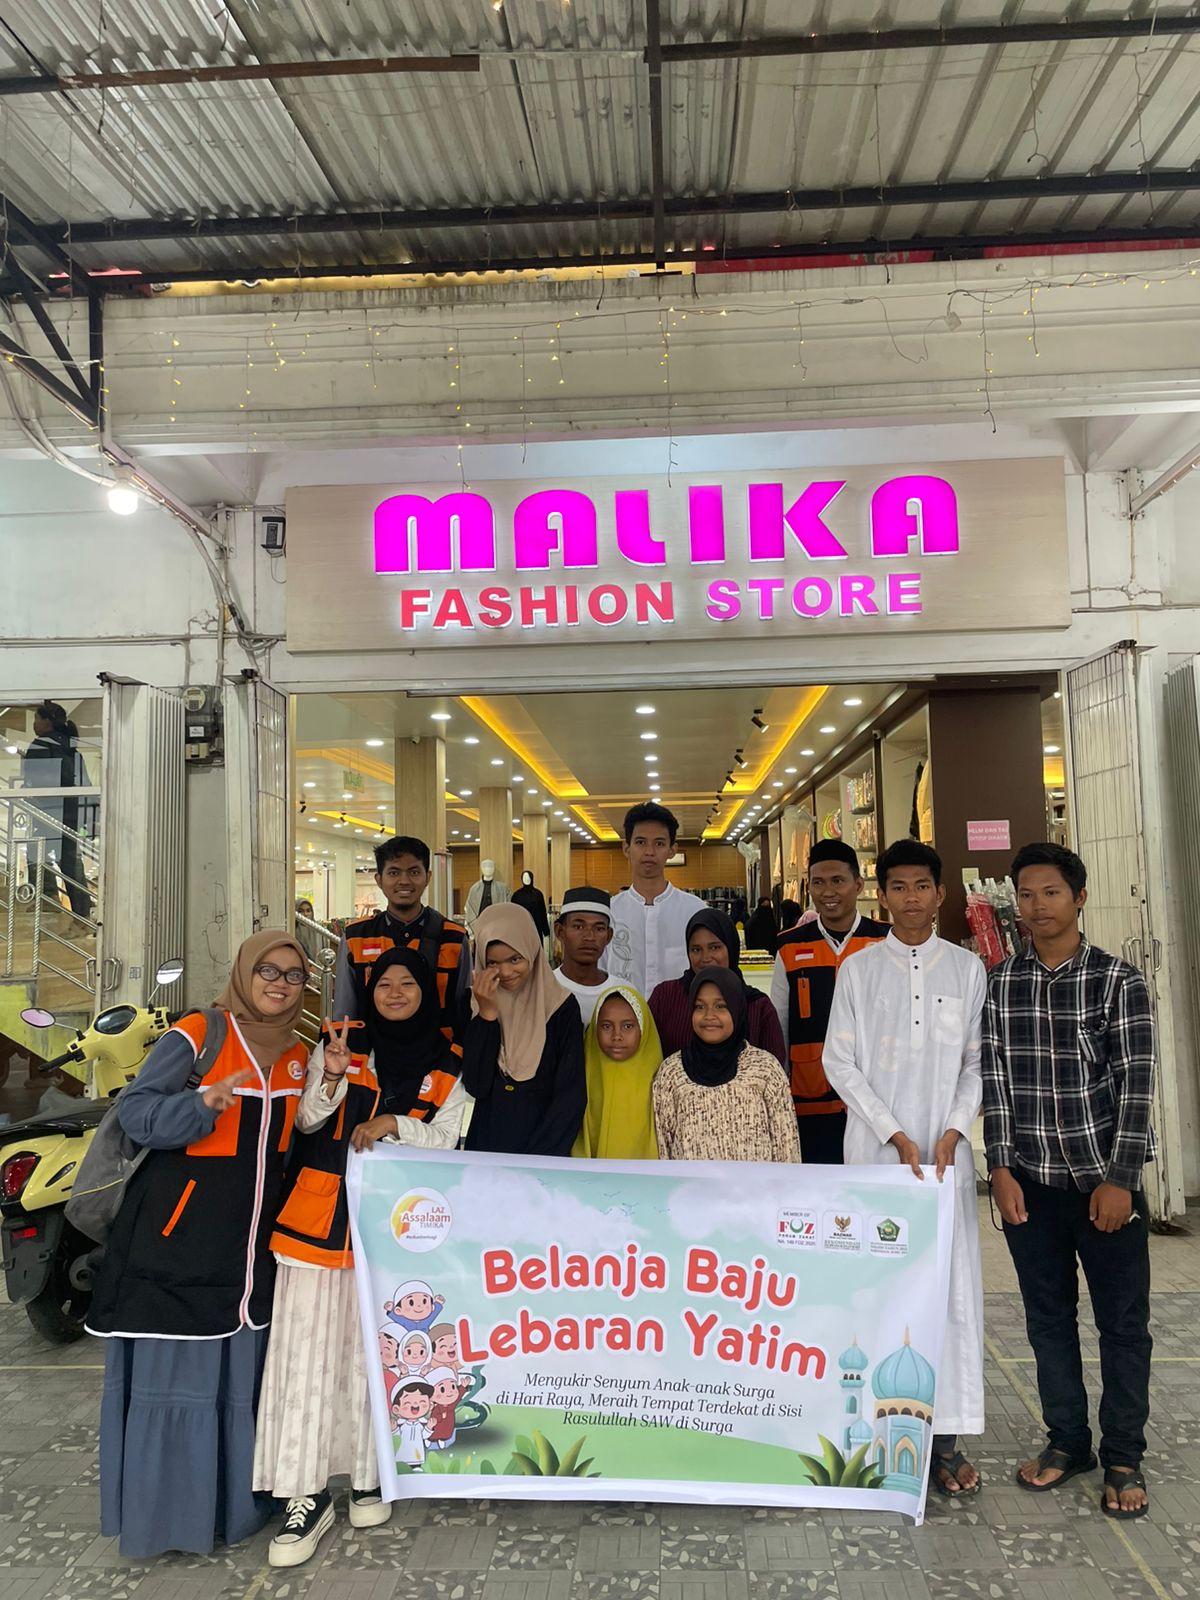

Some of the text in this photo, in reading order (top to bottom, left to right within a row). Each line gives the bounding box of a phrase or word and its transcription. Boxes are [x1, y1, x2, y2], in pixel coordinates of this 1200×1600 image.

[374, 475, 959, 575] MALIKA
[400, 572, 923, 631] FASHION STORE
[401, 1212, 451, 1222] Assalaam
[431, 1206, 445, 1214] LAZ
[484, 1243, 796, 1311] Belanja Baju
[459, 1309, 827, 1380] Lebaran Yatim
[524, 1373, 776, 1401] Mengukir Senyum Anak-anak Surga
[495, 1391, 803, 1418] di Hari Raya, Meraih Tempat Terdekat di Sisi
[563, 1411, 734, 1436] Rasulullah SAW di Surga
